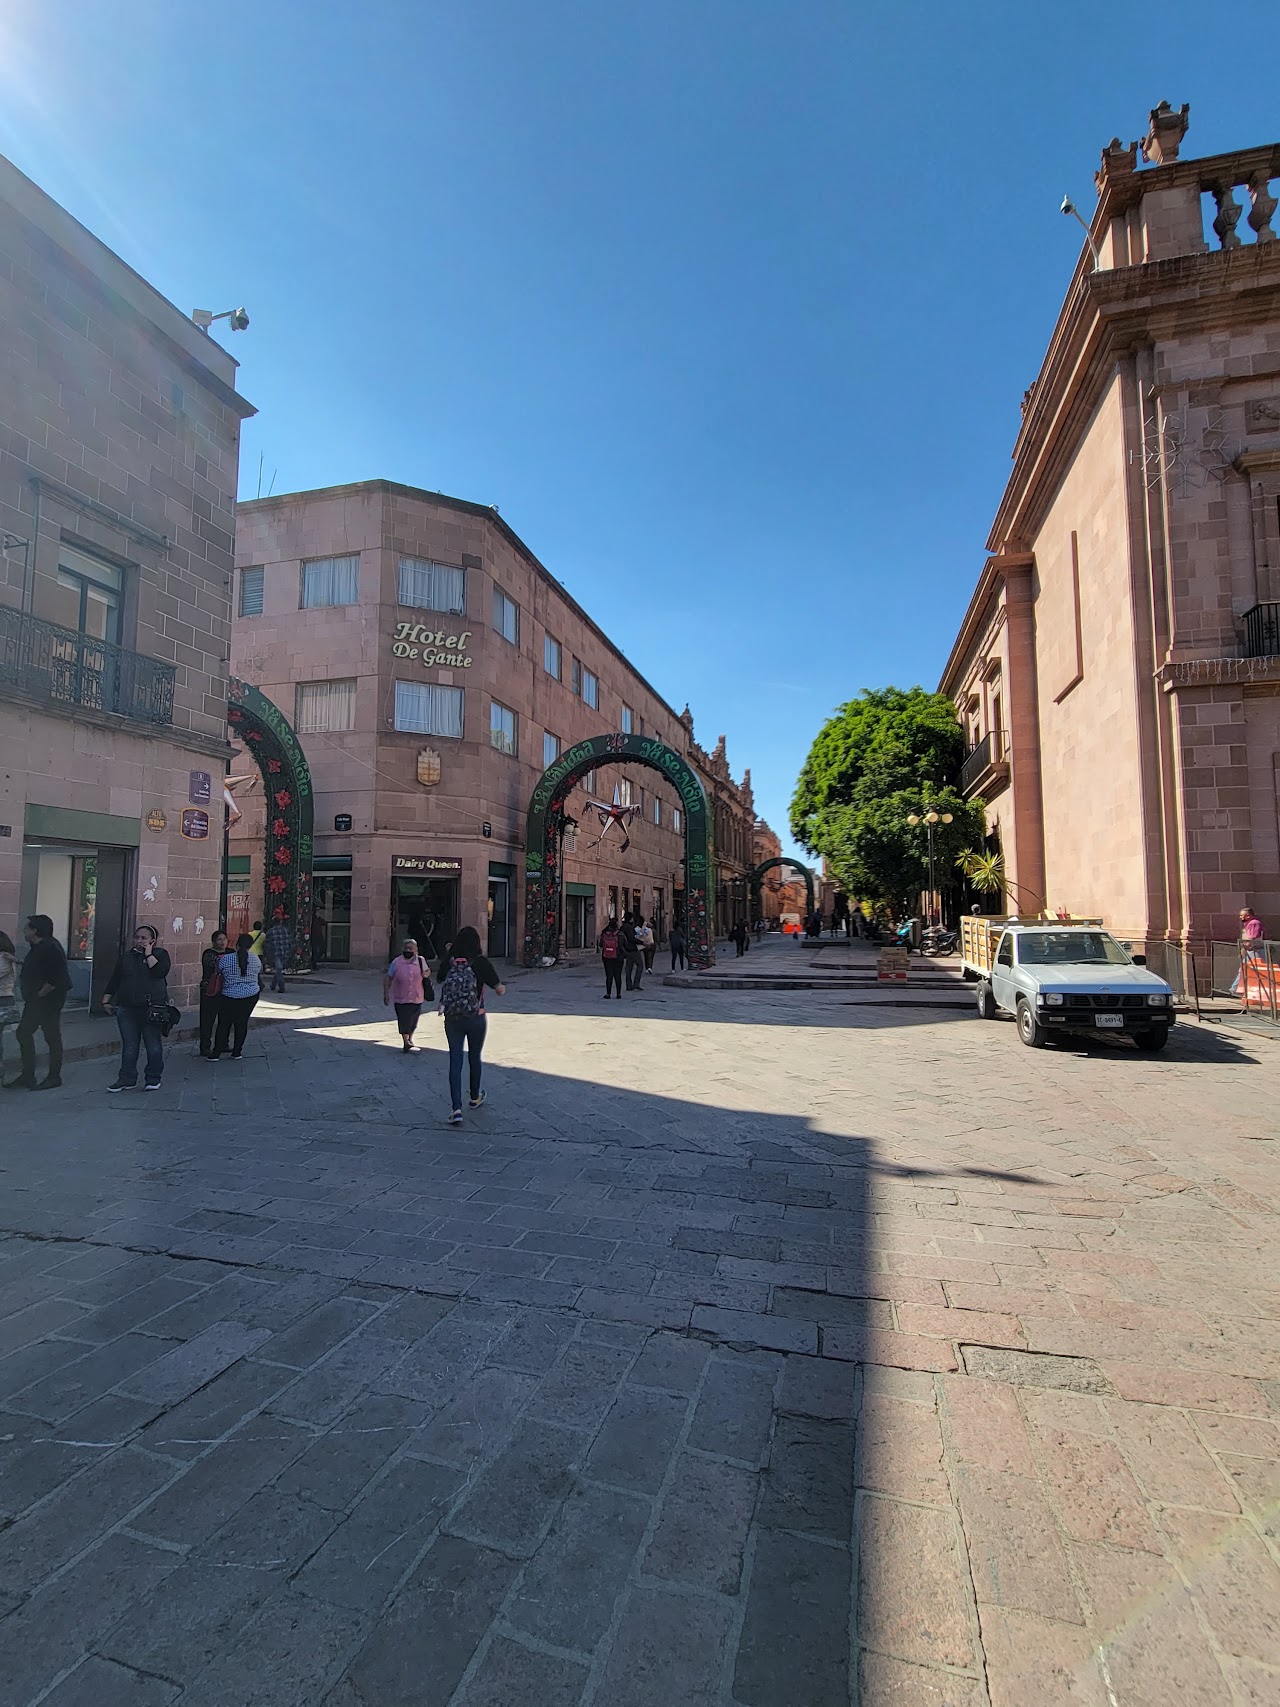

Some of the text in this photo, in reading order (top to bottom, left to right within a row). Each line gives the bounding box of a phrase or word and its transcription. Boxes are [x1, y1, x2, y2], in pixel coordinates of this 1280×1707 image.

[394, 623, 472, 650] Hotel
[393, 642, 472, 668] De Gante
[396, 858, 425, 870] Dairy
